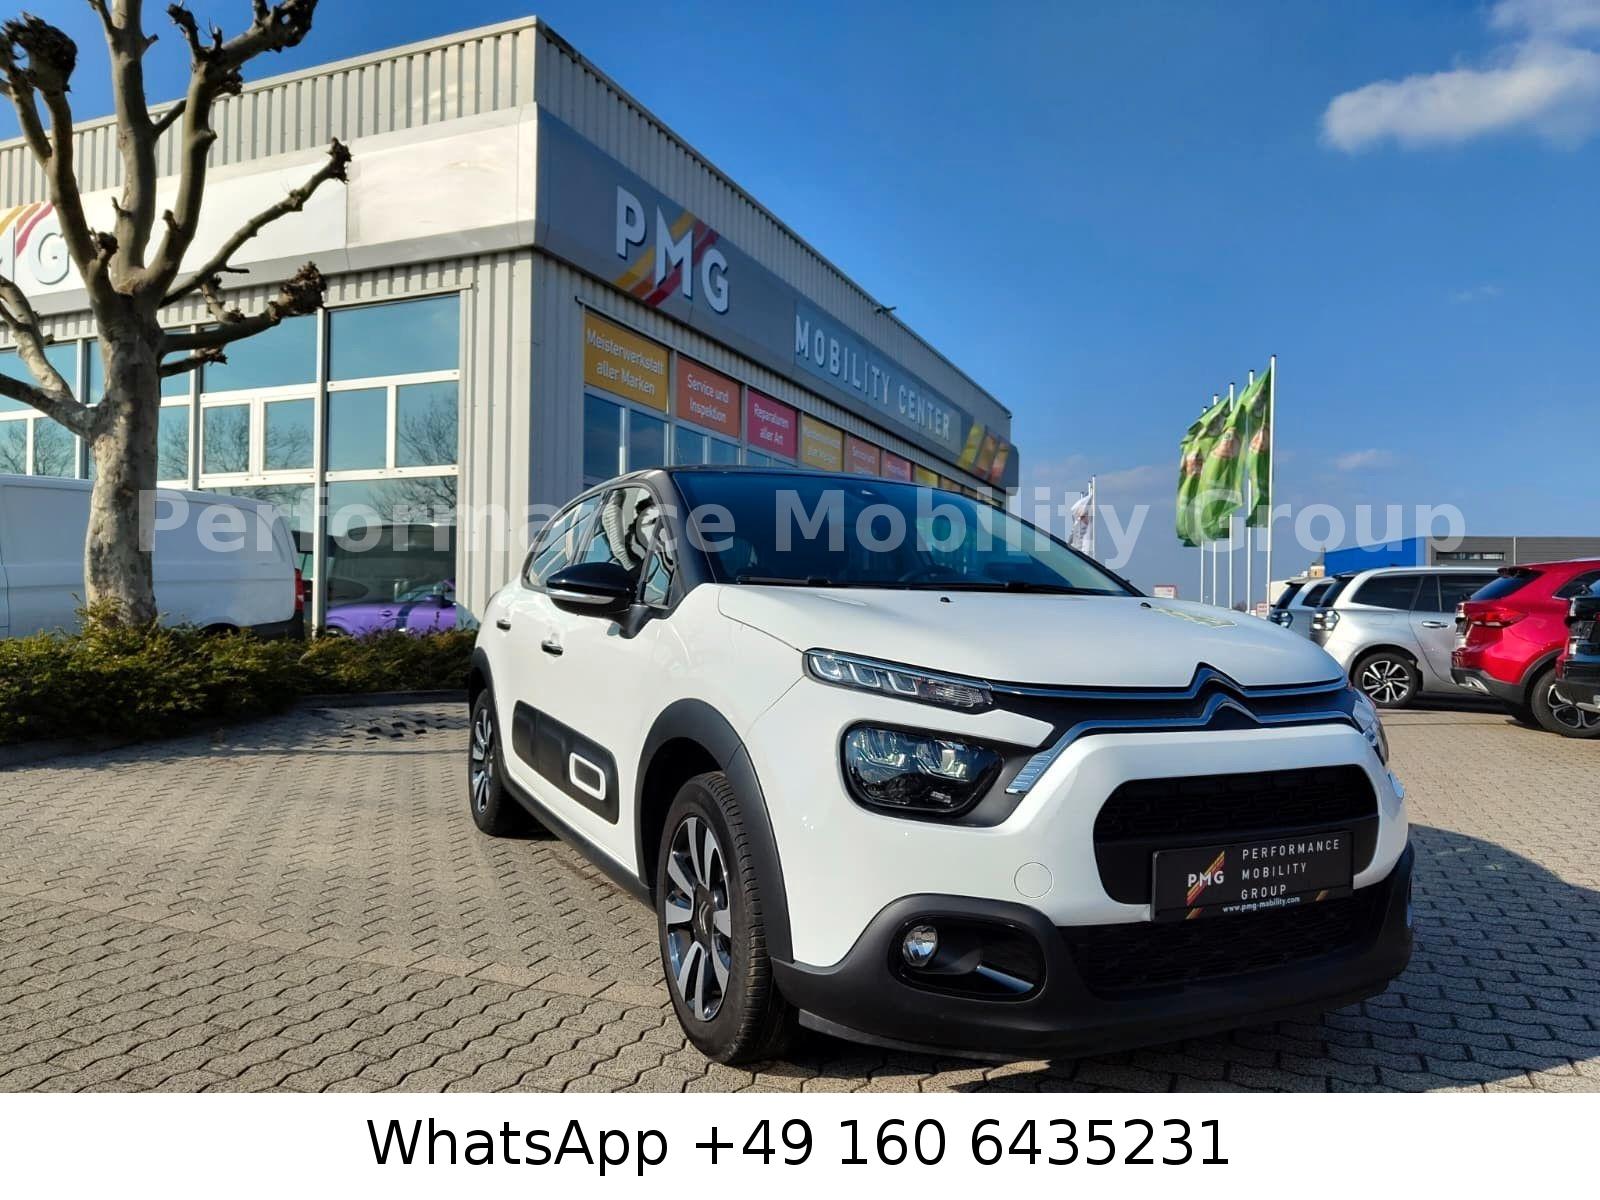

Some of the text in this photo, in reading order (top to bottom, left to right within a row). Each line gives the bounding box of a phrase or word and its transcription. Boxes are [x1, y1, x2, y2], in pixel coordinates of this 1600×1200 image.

[615, 185, 730, 315] PMG
[586, 328, 665, 376] Meisterwerkstatt
[596, 361, 655, 396] aller Marken
[687, 373, 729, 404] Service und
[795, 313, 951, 441] MOBILITY CENTER
[689, 398, 727, 424] Inspektion
[753, 403, 790, 429] Reparaturen
[759, 427, 784, 446] aller Art
[1242, 839, 1340, 861] PERFORMANCE
[1187, 870, 1225, 888] PMG
[1241, 862, 1307, 881] MOBILITY
[1241, 884, 1287, 901] GROUP
